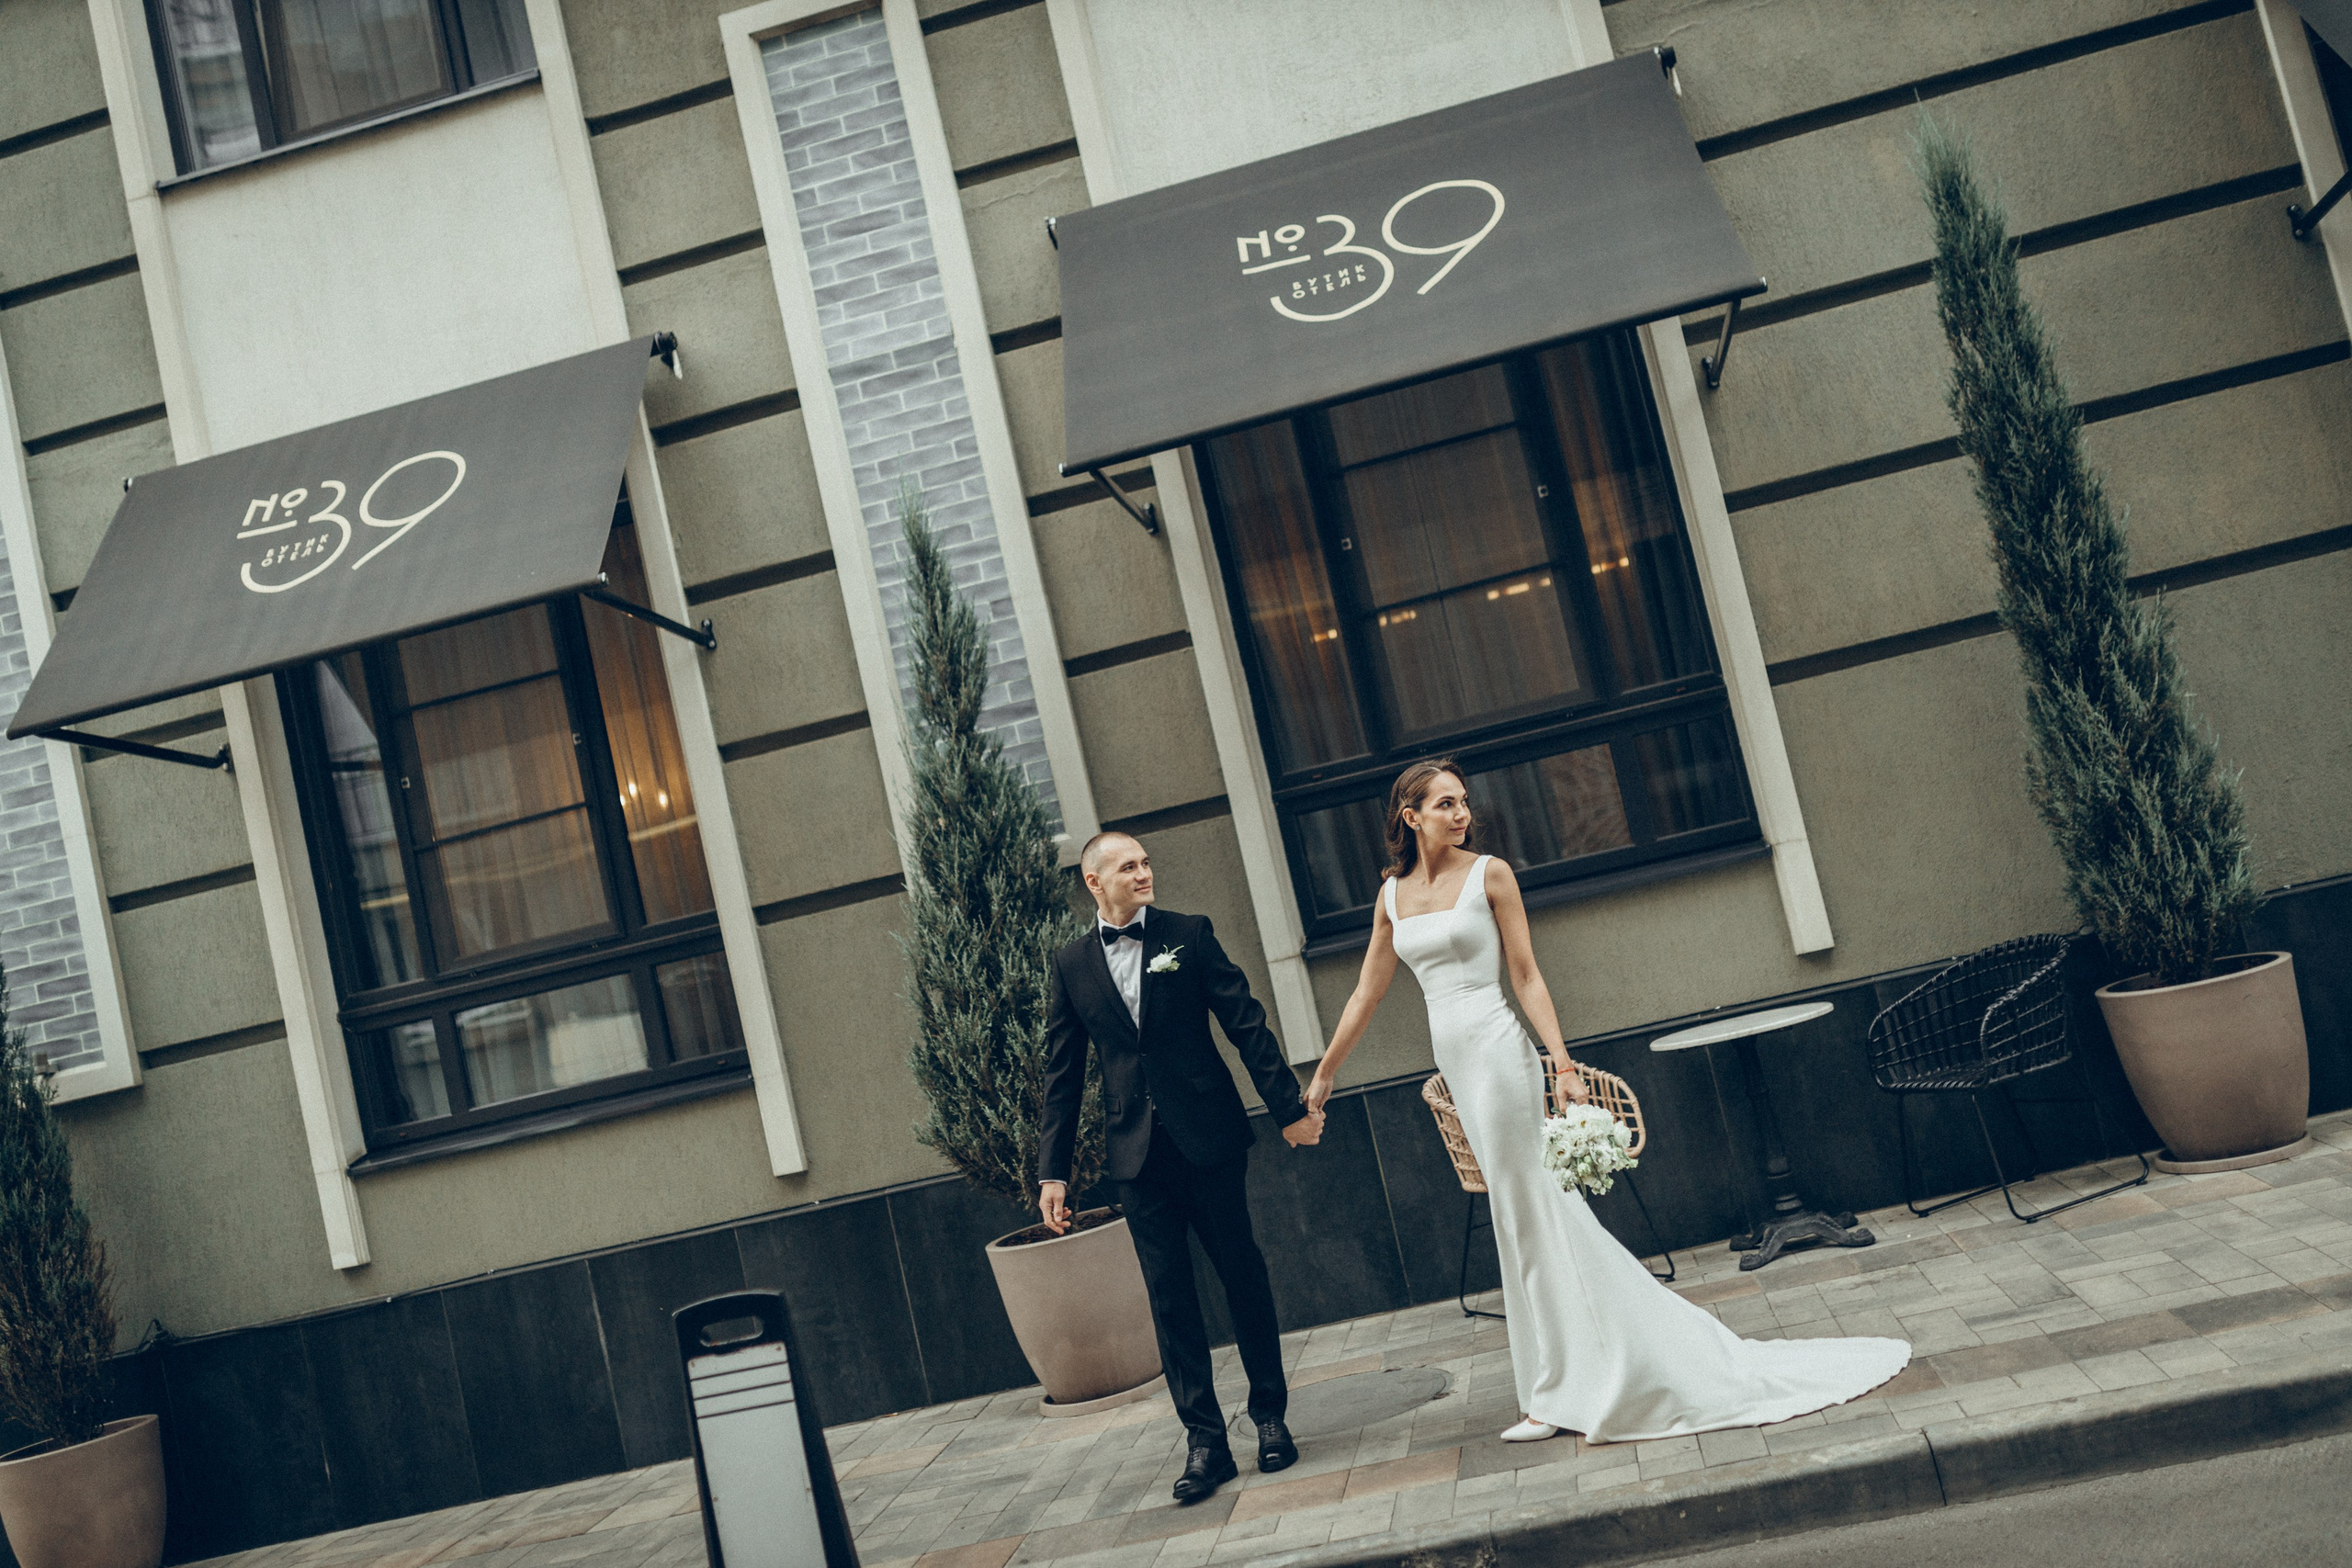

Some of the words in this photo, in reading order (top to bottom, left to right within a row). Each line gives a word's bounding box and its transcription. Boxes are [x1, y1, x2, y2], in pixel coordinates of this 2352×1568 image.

[1271, 179, 1506, 322] 39
[1292, 264, 1366, 291] БУТИК
[1292, 273, 1367, 299] ОТЕЛЬ
[241, 450, 467, 594] 39
[261, 543, 325, 568] ОТЕЛЬ
